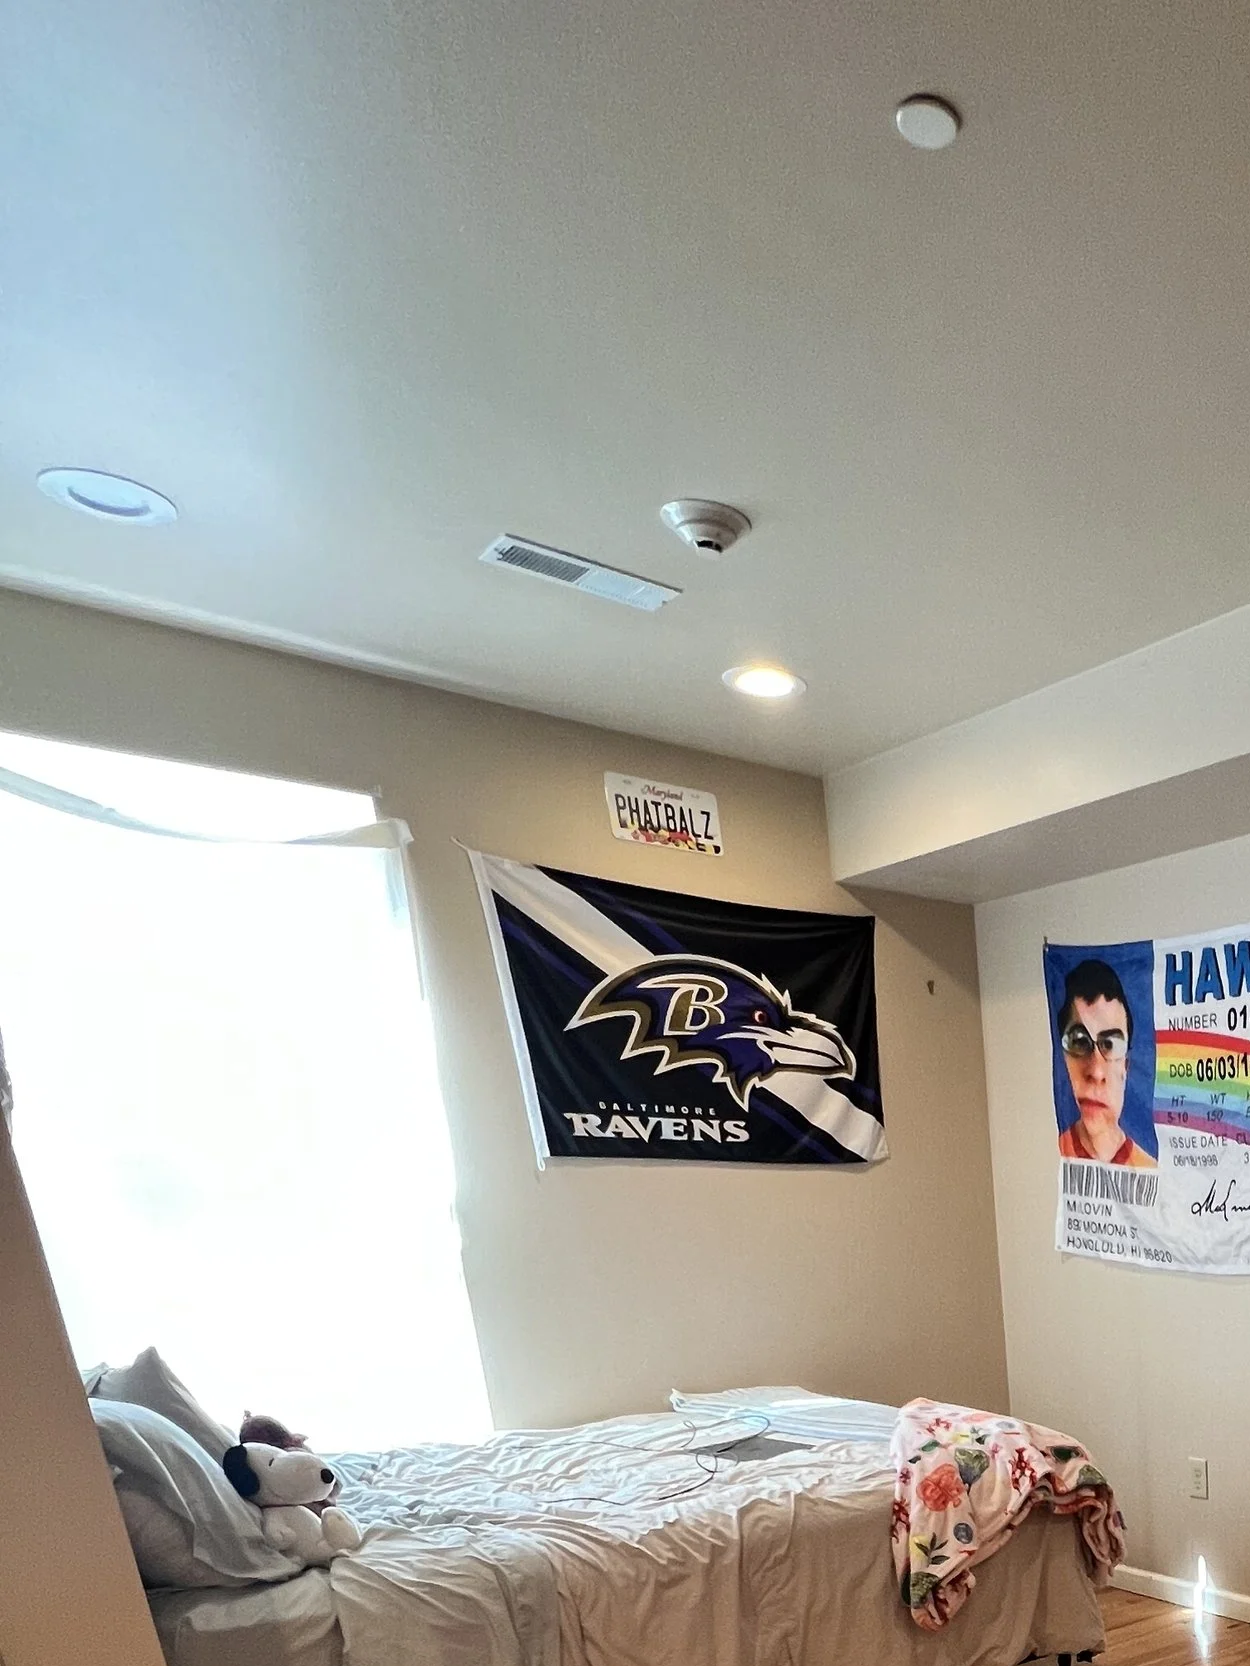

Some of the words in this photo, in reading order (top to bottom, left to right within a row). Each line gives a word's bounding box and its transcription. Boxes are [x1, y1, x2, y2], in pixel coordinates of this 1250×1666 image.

[641, 784, 683, 801] Maryland
[615, 793, 714, 840] PHATBALZ
[1168, 1013, 1218, 1032] NUMBER
[1169, 1063, 1193, 1078] DOB
[1171, 1095, 1186, 1107] HT
[1210, 1093, 1227, 1105] WT
[599, 1101, 716, 1116] BALTIMORE
[563, 1112, 750, 1143] RAVENS
[1169, 1136, 1198, 1149] ISSUE
[1200, 1134, 1228, 1148] DATE
